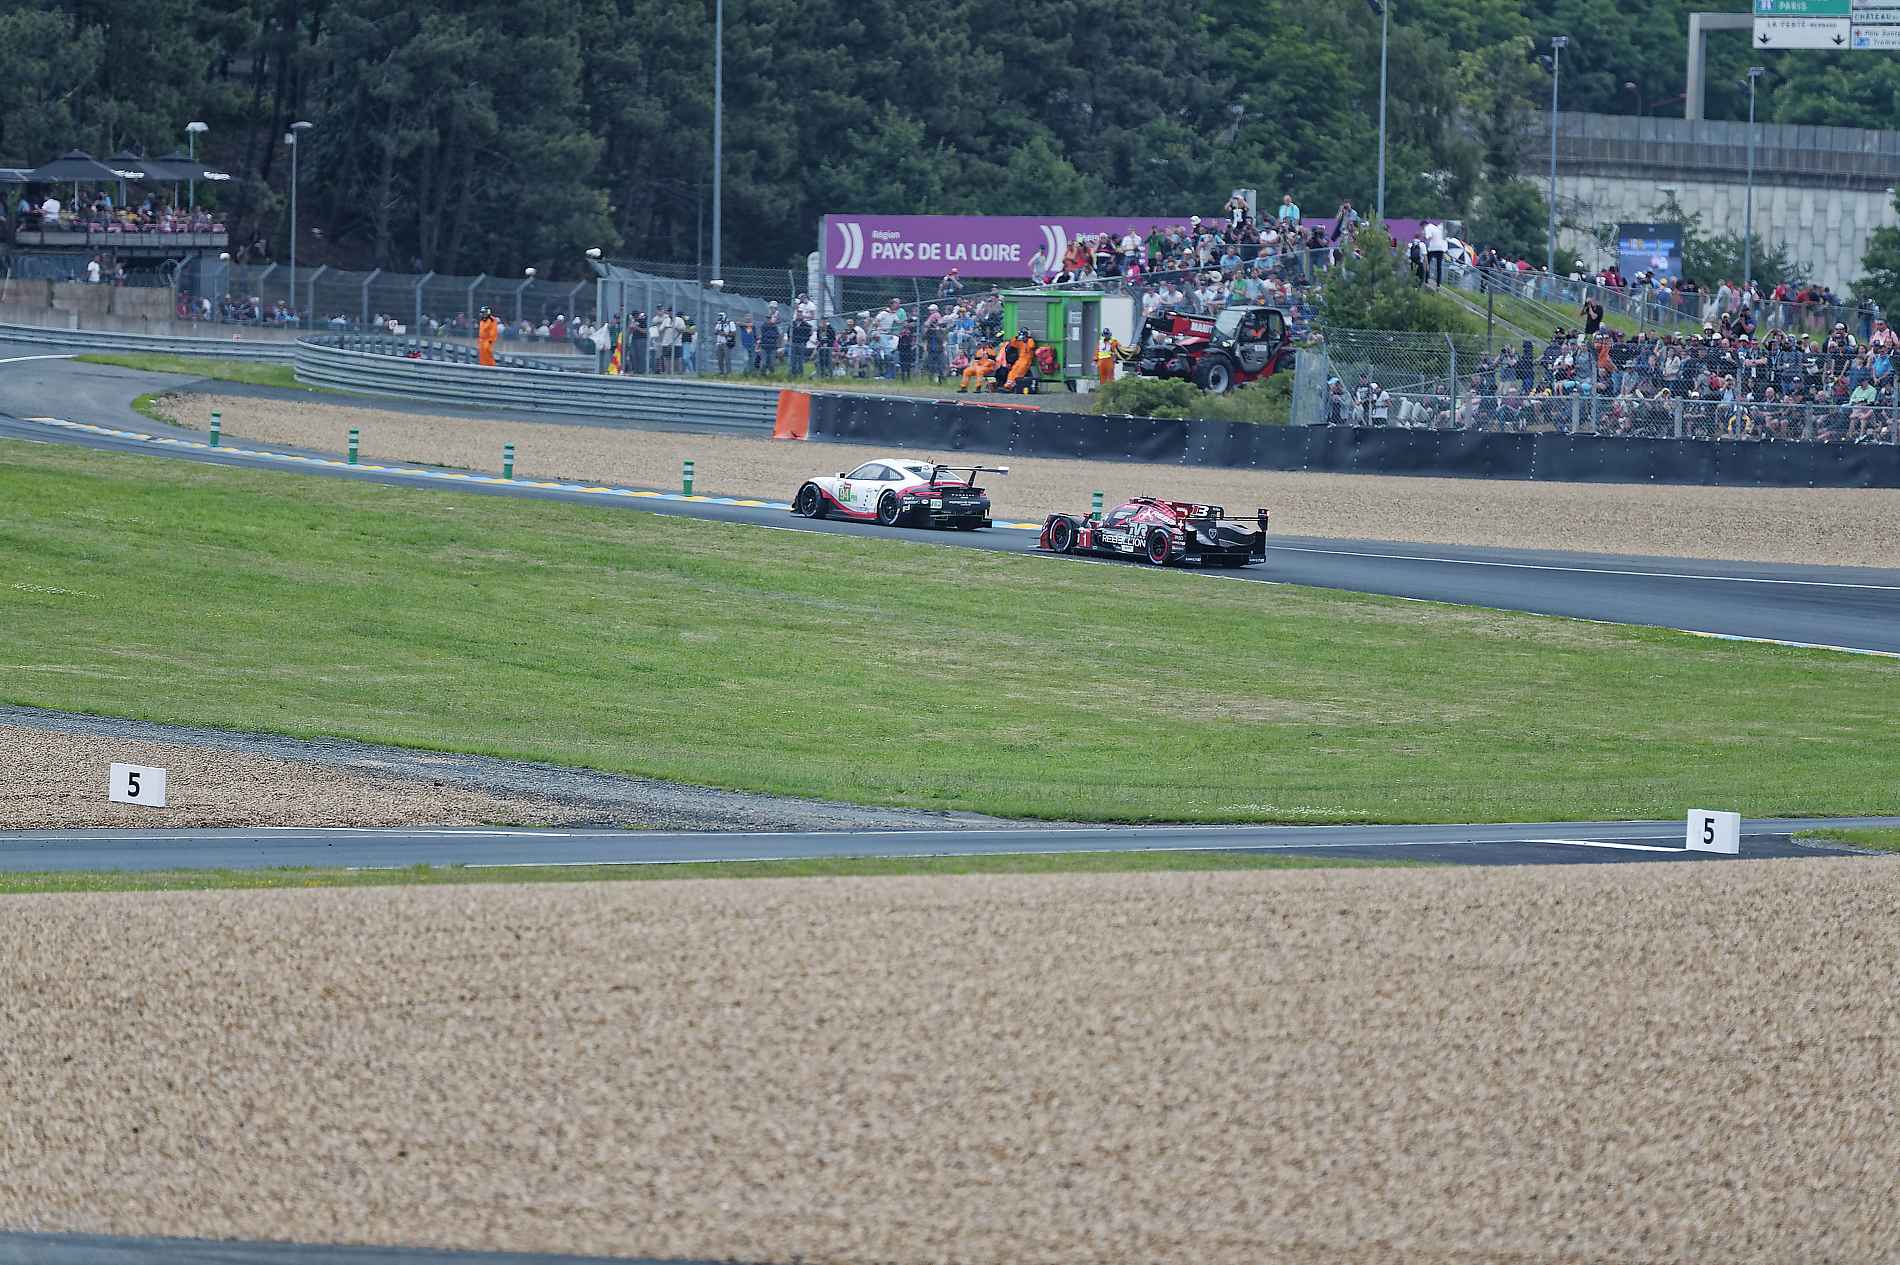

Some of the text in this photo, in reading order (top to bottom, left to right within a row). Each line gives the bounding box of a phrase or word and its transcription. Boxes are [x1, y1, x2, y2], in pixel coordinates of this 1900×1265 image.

[872, 230, 900, 240] Région
[871, 242, 1021, 262] PAYS DE LA LOIRE
[1102, 534, 1147, 548] REBELLION
[128, 772, 140, 797] 5
[1703, 818, 1715, 844] 5
